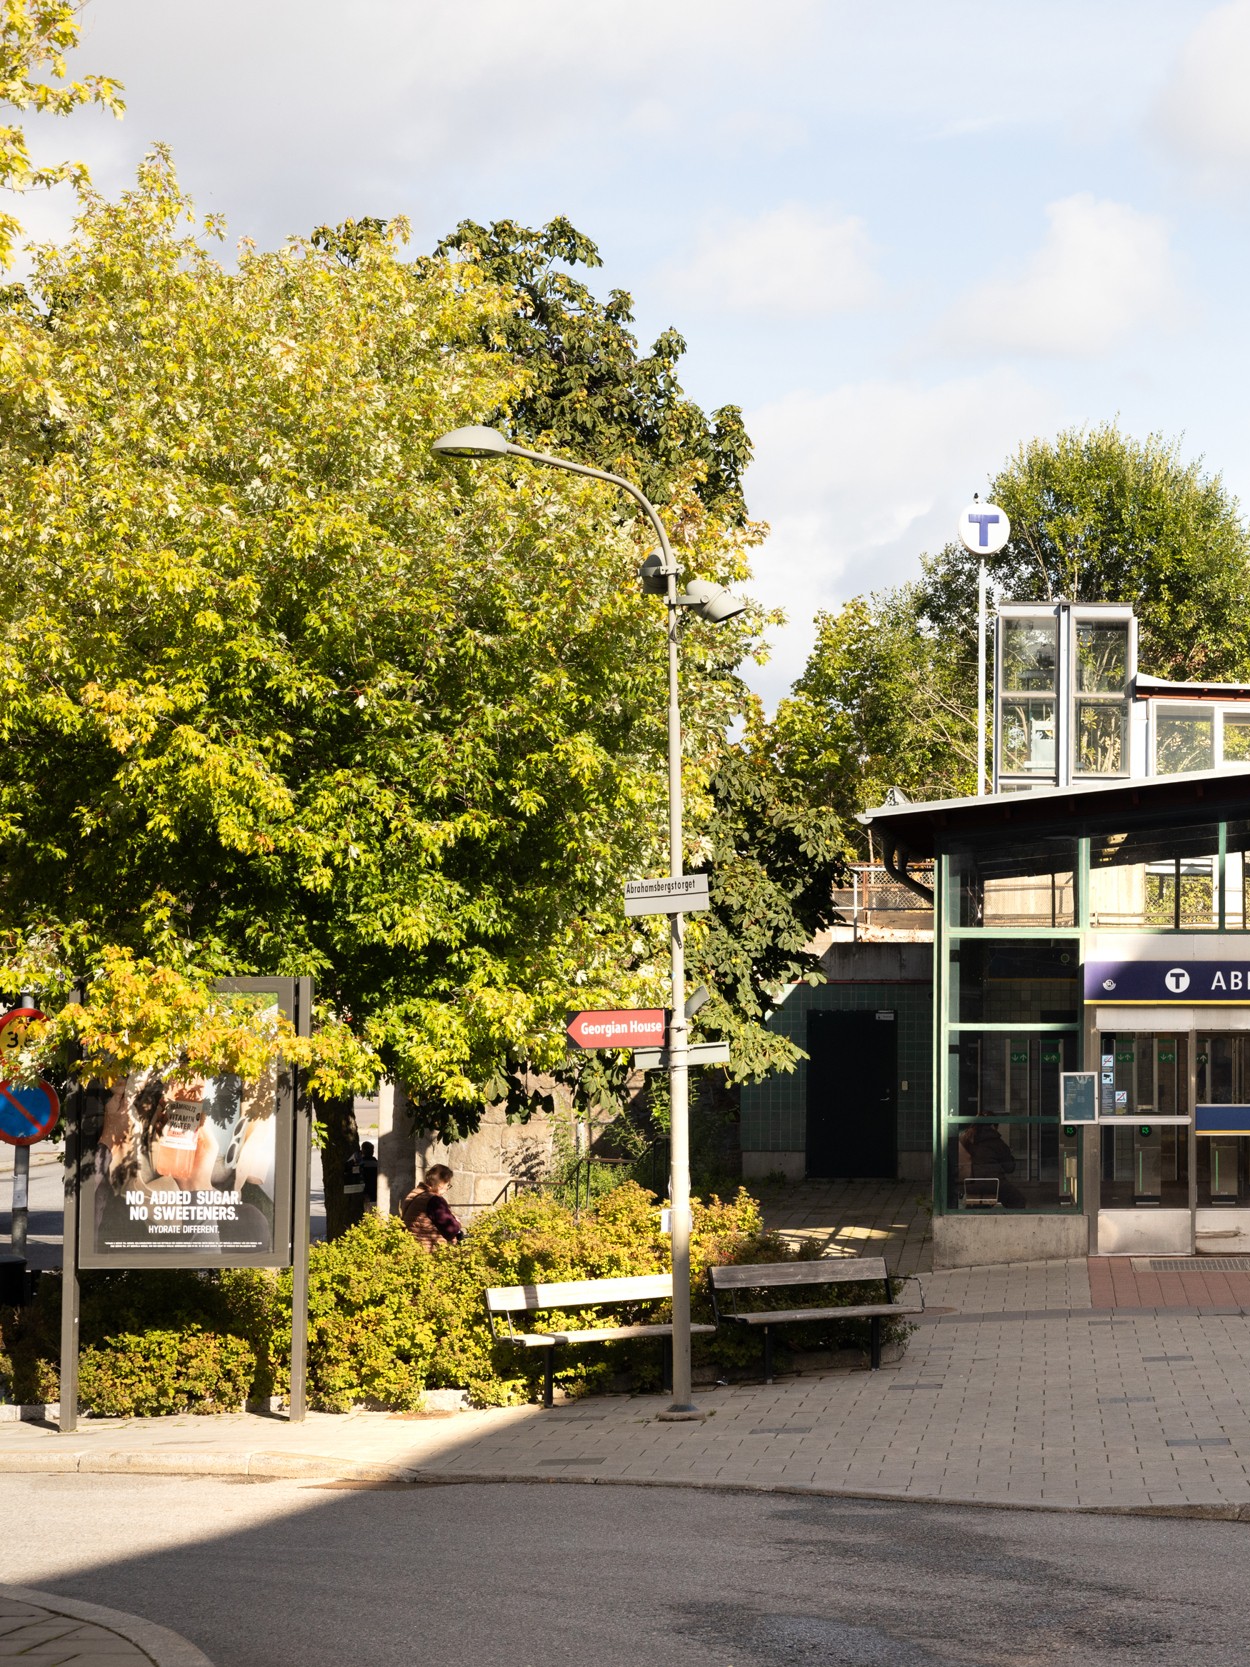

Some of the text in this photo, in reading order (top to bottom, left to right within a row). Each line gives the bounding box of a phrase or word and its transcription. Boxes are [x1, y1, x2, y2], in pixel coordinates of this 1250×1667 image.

[968, 514, 999, 546] T
[626, 879, 696, 894] Abrahamsbergstorget
[1170, 973, 1185, 989] T
[580, 1020, 663, 1038] Georgian House
[126, 1191, 243, 1205] NO ADDED SUGAR.
[129, 1206, 239, 1220] NO SWEETENERS.
[148, 1225, 220, 1234] HYDRATE DIFFERENT.
